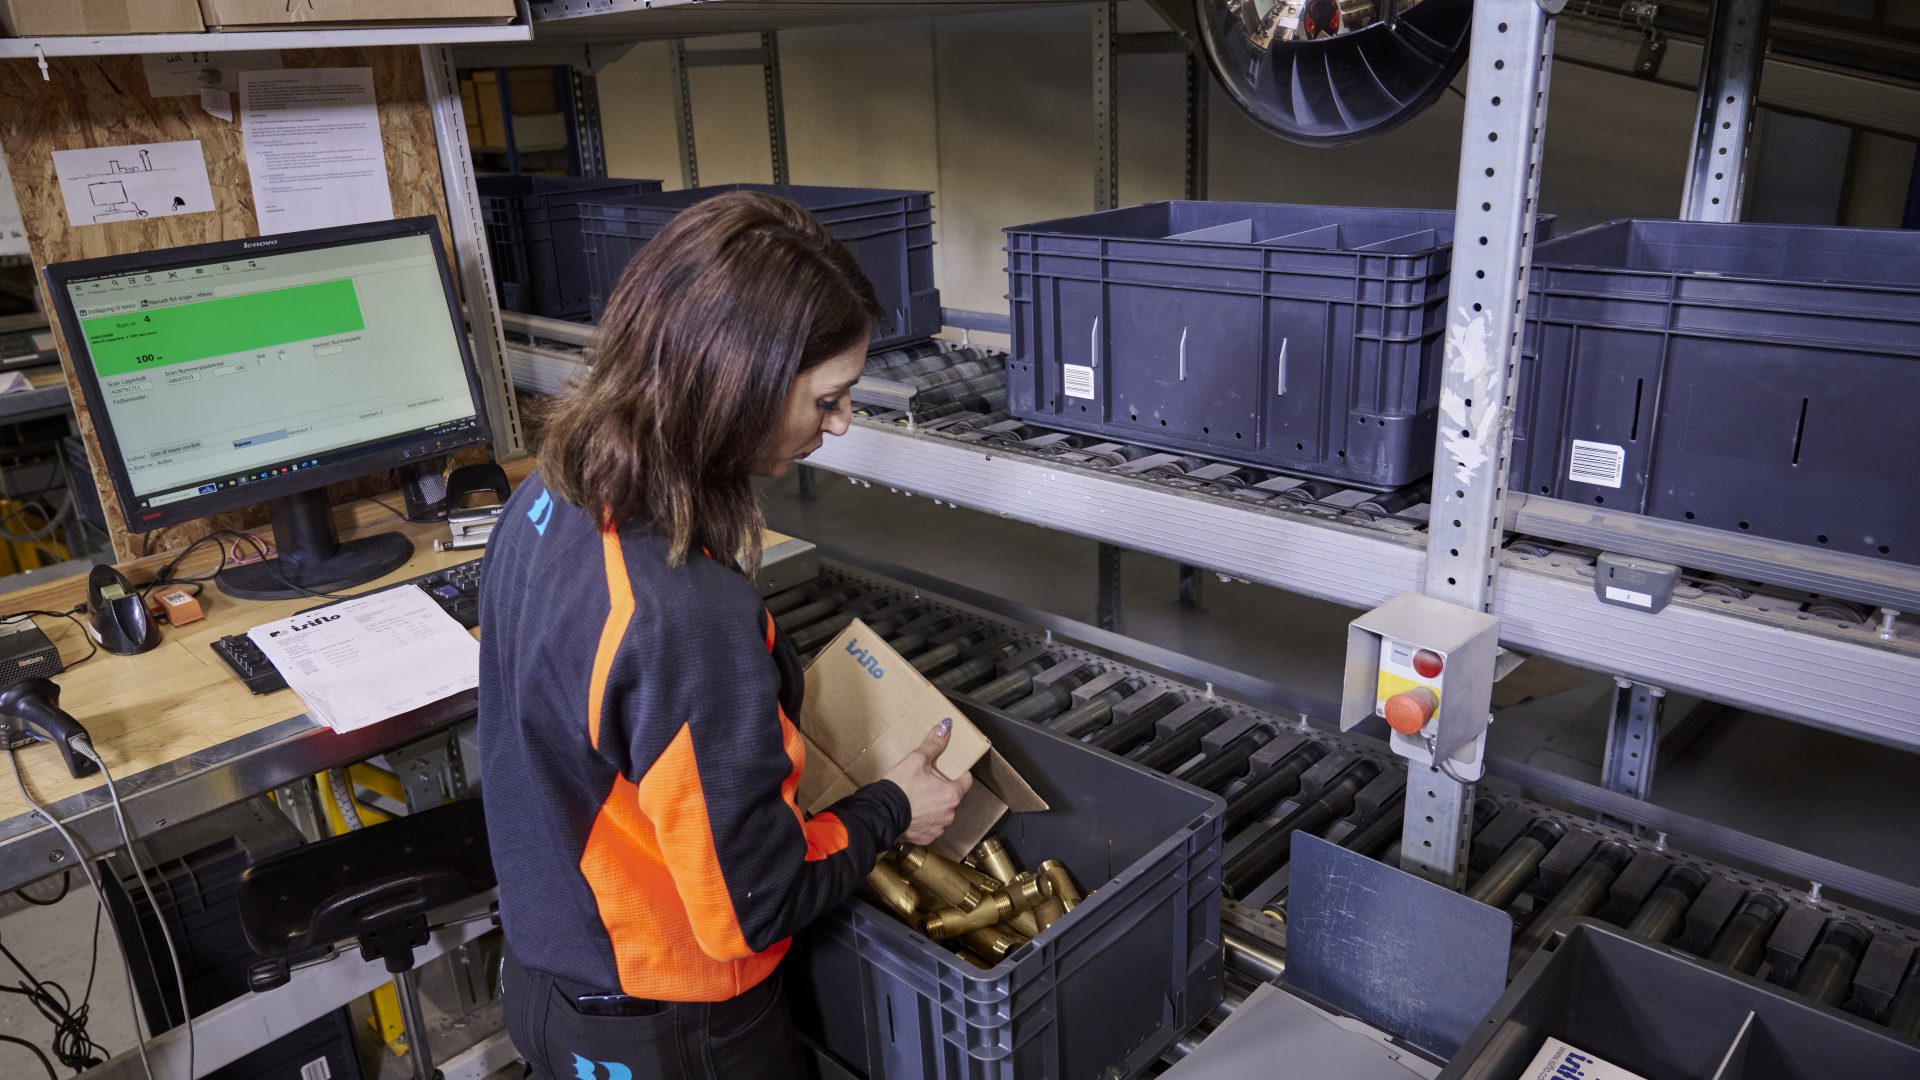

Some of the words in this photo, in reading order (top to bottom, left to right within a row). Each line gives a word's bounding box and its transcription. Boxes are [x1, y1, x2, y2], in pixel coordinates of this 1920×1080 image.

[243, 239, 278, 249] lenovo
[144, 315, 151, 323] 4
[135, 353, 154, 364] 100
[290, 612, 341, 632] isiflo
[845, 638, 884, 679] isiflo
